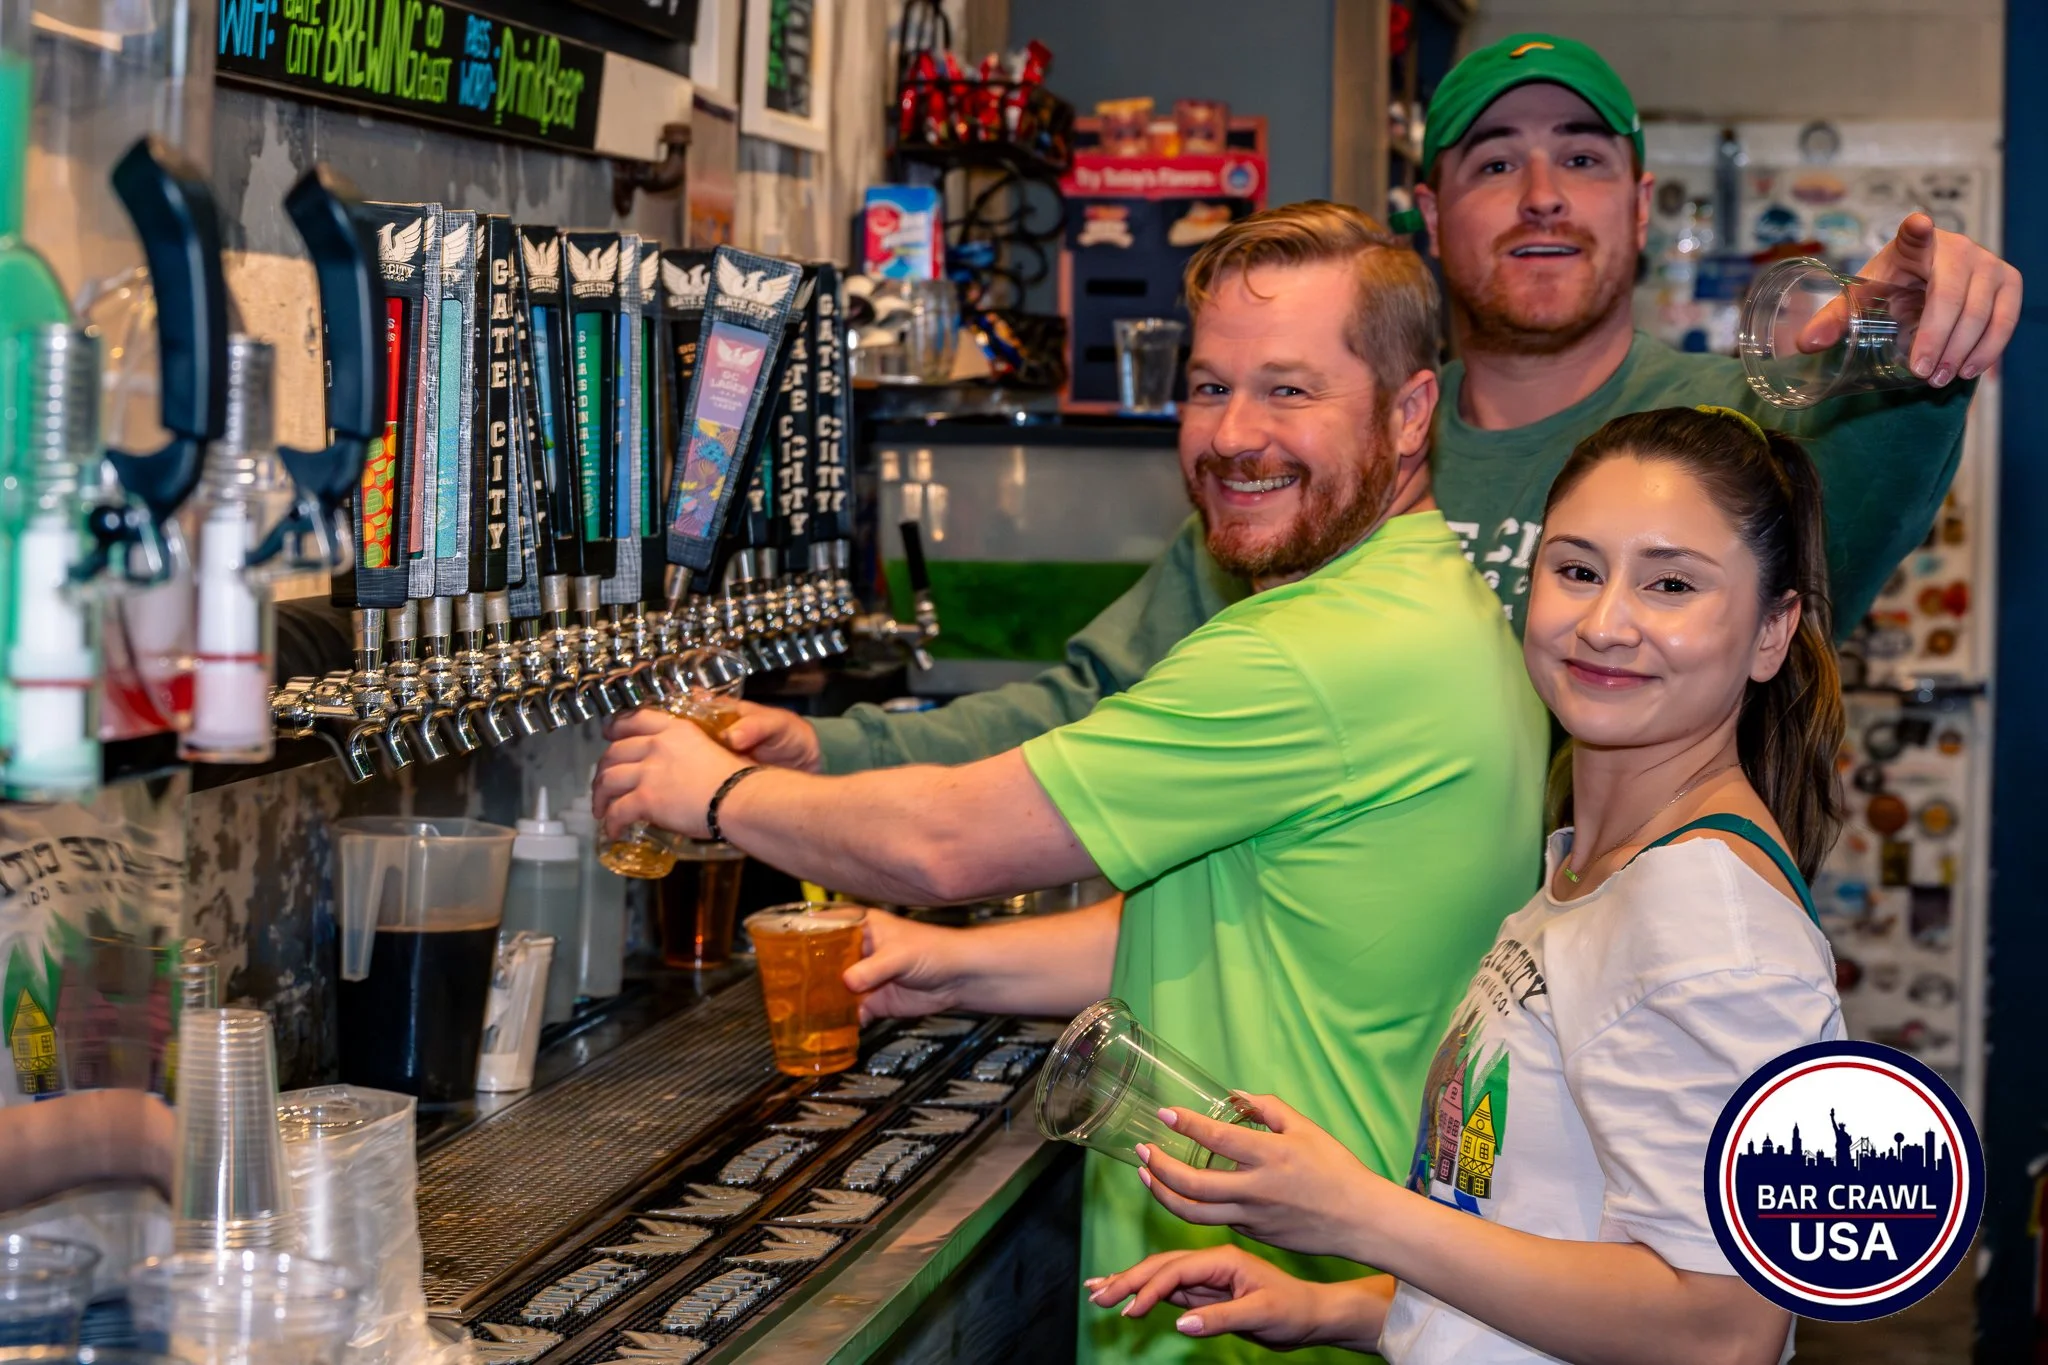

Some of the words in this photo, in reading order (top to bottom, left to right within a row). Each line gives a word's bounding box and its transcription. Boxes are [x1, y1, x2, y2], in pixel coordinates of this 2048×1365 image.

[286, 23, 324, 77] CITY
[385, 264, 415, 278] CITY
[573, 283, 595, 296] GATE
[595, 282, 614, 294] CITY
[491, 259, 510, 388] GATE
[817, 293, 834, 393] GATE
[577, 330, 589, 456] SEASONAL
[488, 421, 507, 550] CITY
[815, 415, 832, 513] CITY
[1502, 949, 1548, 1010] CITY
